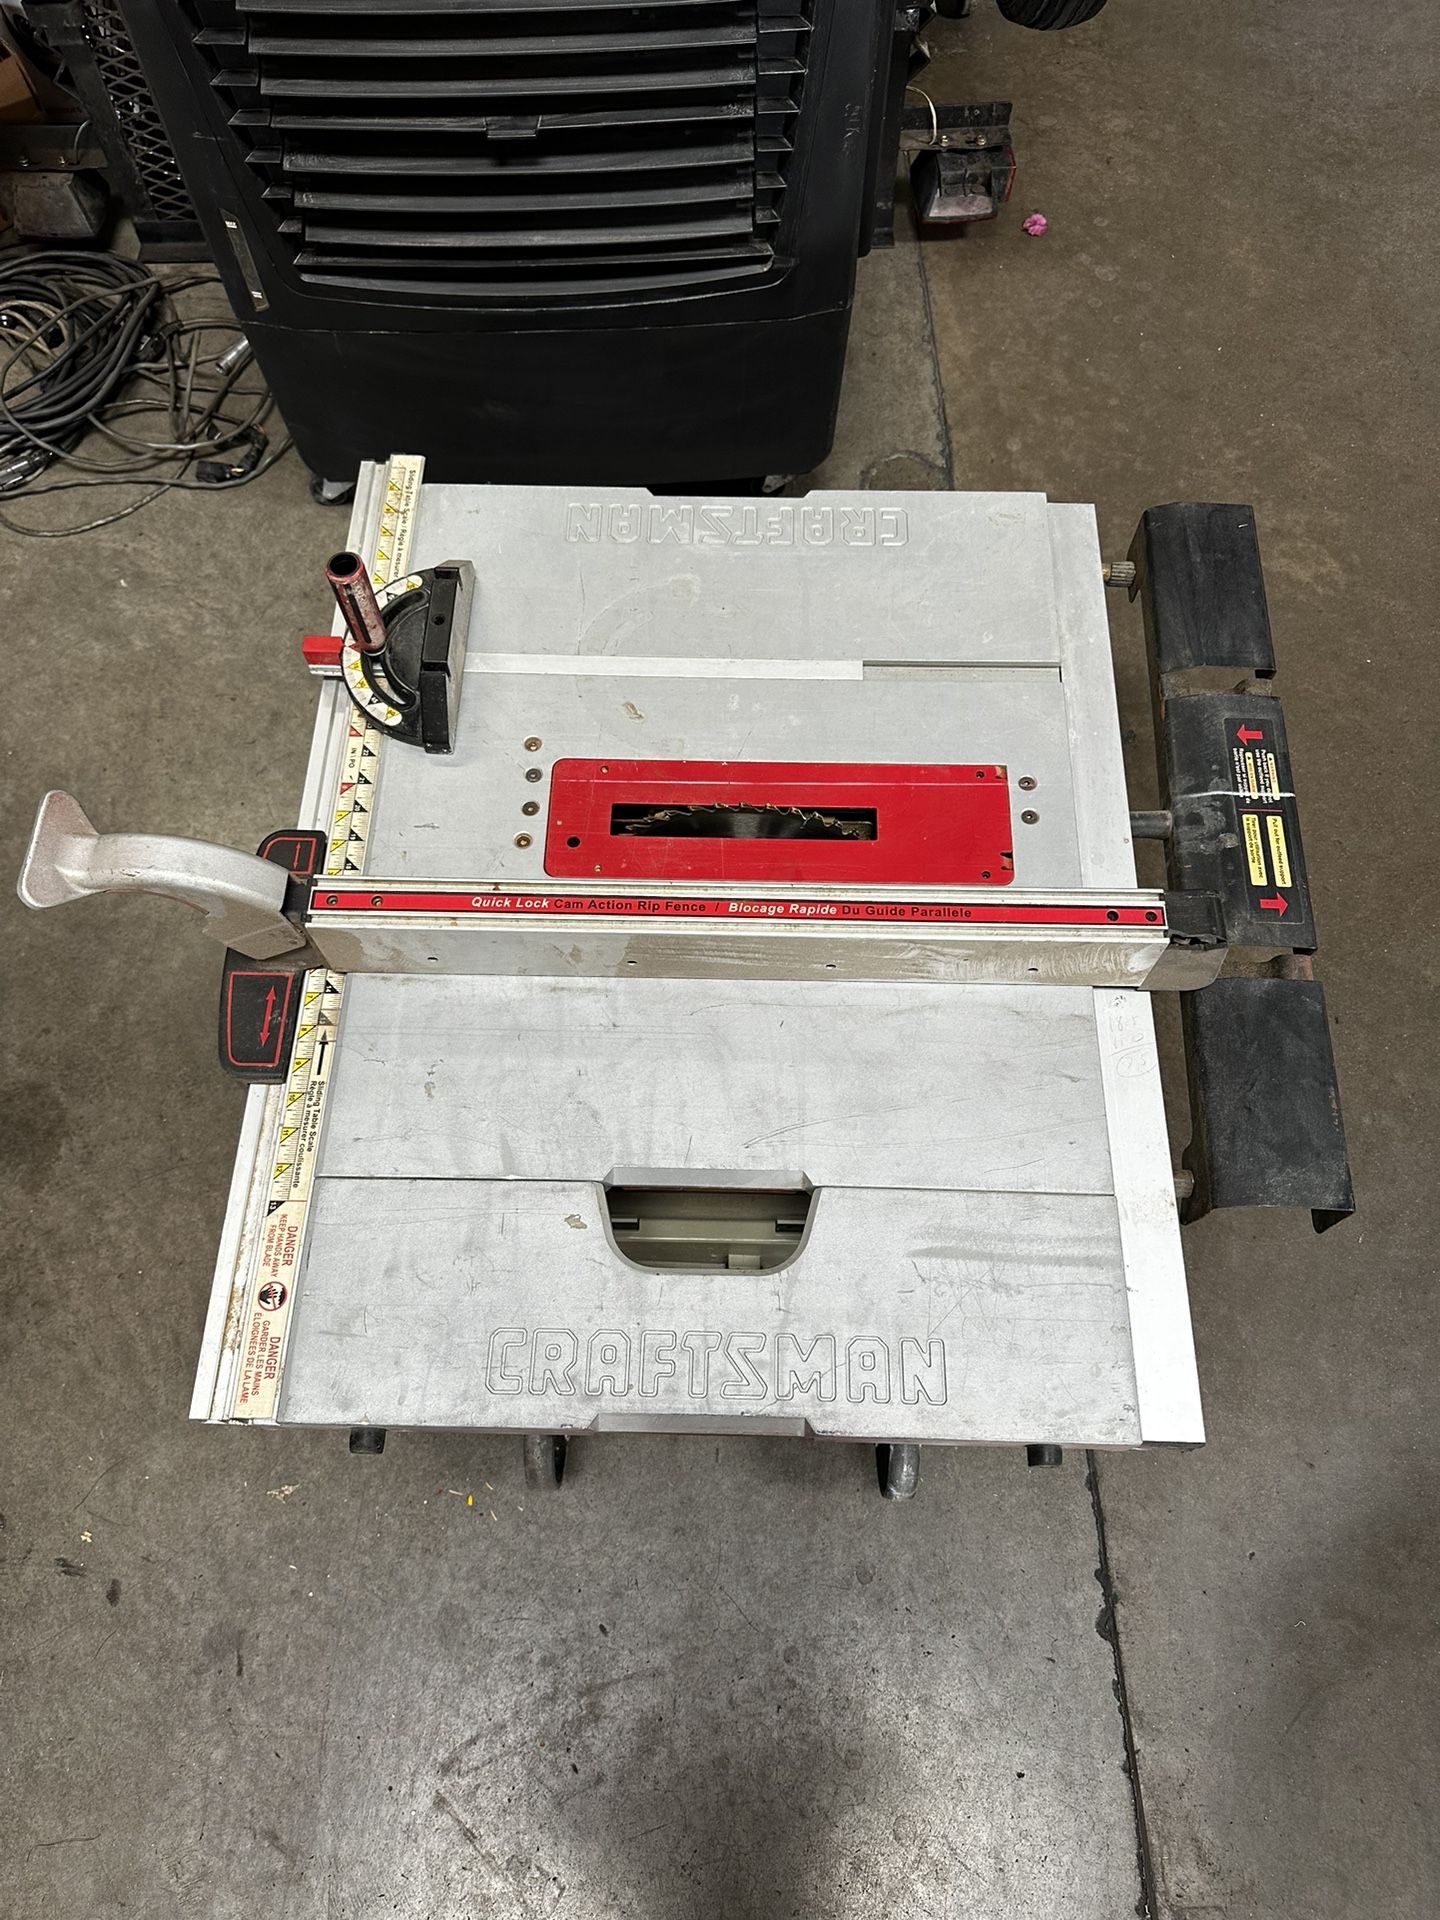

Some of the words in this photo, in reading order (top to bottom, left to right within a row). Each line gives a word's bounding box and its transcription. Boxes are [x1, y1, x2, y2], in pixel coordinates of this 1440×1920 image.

[565, 503, 909, 546] CRAFTSMAN
[471, 896, 511, 908] Quick
[516, 898, 550, 908] Lock
[554, 898, 584, 910] Cam
[588, 899, 632, 910] Action
[637, 900, 660, 912] Rip
[665, 901, 706, 912] Fence
[728, 902, 784, 916] Blocage
[788, 904, 838, 916] Rapide
[842, 905, 860, 916] Du
[865, 906, 906, 916] Guide
[911, 907, 972, 918] Parallele
[313, 1080, 325, 1106] Sliding
[301, 1110, 311, 1141] mesurer
[311, 1109, 320, 1129] Table
[307, 1131, 316, 1152] Scale
[293, 1143, 305, 1188] coulissante
[267, 1224, 277, 1243] FROM
[279, 1214, 288, 1232] KEEP
[274, 1233, 284, 1256] HANDS
[282, 1226, 298, 1266] DANGER
[262, 1245, 273, 1267] BLADE
[271, 1258, 280, 1277] AWAY
[258, 1320, 270, 1352] GARDER
[246, 1358, 255, 1368] DE
[256, 1355, 264, 1369] LES
[264, 1336, 281, 1380] DANGER
[484, 1327, 946, 1406] CRAFTSMAN
[243, 1370, 252, 1380] LA
[251, 1371, 262, 1396] MAINS
[240, 1382, 250, 1403] LAME
